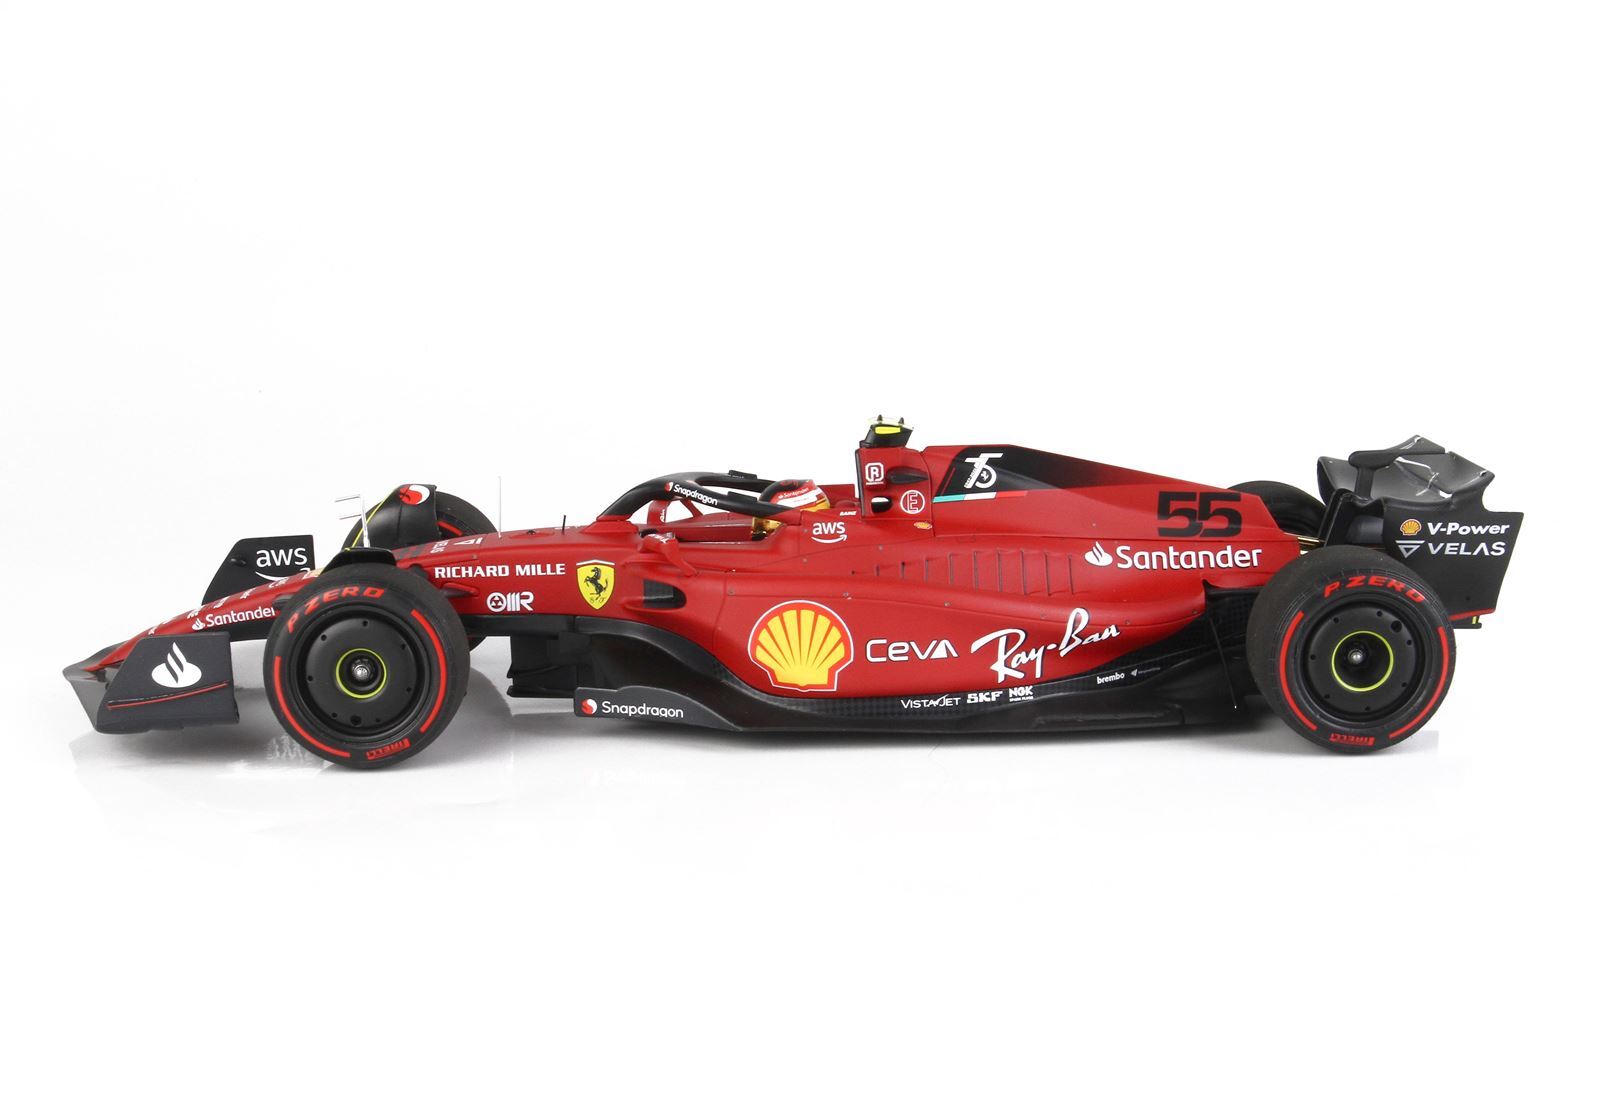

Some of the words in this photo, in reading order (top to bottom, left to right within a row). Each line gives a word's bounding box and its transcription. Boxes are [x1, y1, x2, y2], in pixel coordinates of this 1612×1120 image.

[673, 484, 718, 506] Snapdragon
[1157, 491, 1243, 538] 55
[812, 521, 846, 535] aws
[1427, 522, 1510, 536] V-Power
[256, 547, 308, 568] aws
[1116, 545, 1262, 570] Santander
[1427, 541, 1506, 556] VELAS
[434, 564, 510, 579] RICHARD
[515, 563, 566, 576] MILLE
[1323, 581, 1341, 598] P
[1346, 575, 1425, 603] ZERO
[287, 612, 299, 634] P
[304, 586, 385, 615] ZERO
[970, 607, 1120, 683] Ray-Ban
[1096, 672, 1125, 685] brembo
[966, 691, 1003, 704] SKF
[1008, 686, 1033, 697] NGK
[601, 700, 684, 718] Snapdragon
